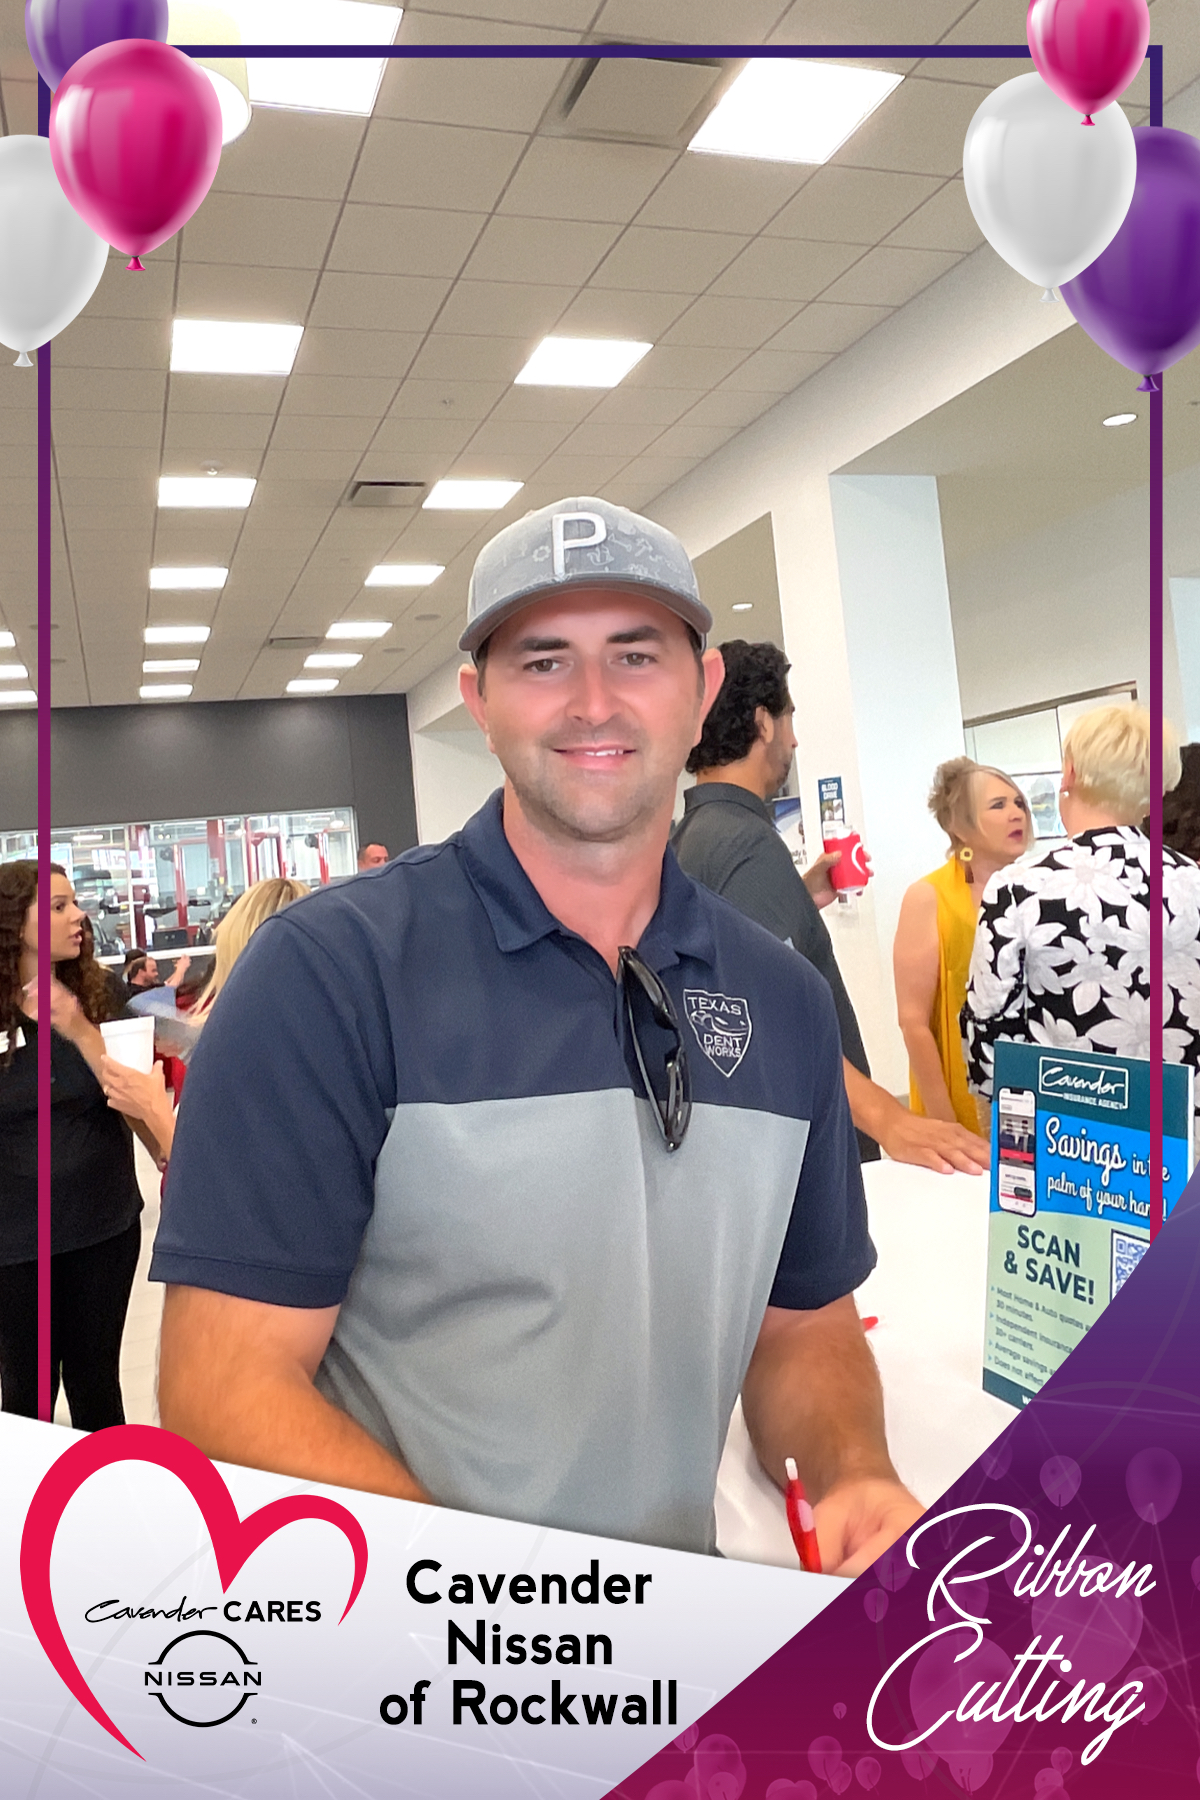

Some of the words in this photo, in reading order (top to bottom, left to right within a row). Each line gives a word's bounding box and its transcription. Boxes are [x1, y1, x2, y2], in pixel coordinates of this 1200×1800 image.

[552, 511, 607, 576] P
[687, 996, 742, 1015] TEXAS
[704, 1033, 742, 1048] DENT
[705, 1044, 742, 1058] WORKS
[1042, 1067, 1125, 1095] Cavender
[1063, 1092, 1097, 1105] INSURANCE
[1099, 1098, 1123, 1110] AGENCY
[1046, 1116, 1127, 1186] Savings
[1132, 1153, 1147, 1175] in
[1047, 1172, 1078, 1198] palm
[1079, 1178, 1093, 1211] of
[1096, 1189, 1128, 1215] your
[1017, 1224, 1080, 1268] SCAN
[1004, 1250, 1018, 1275] &
[1025, 1258, 1094, 1305] SAVE!
[996, 1314, 1038, 1339] Independent
